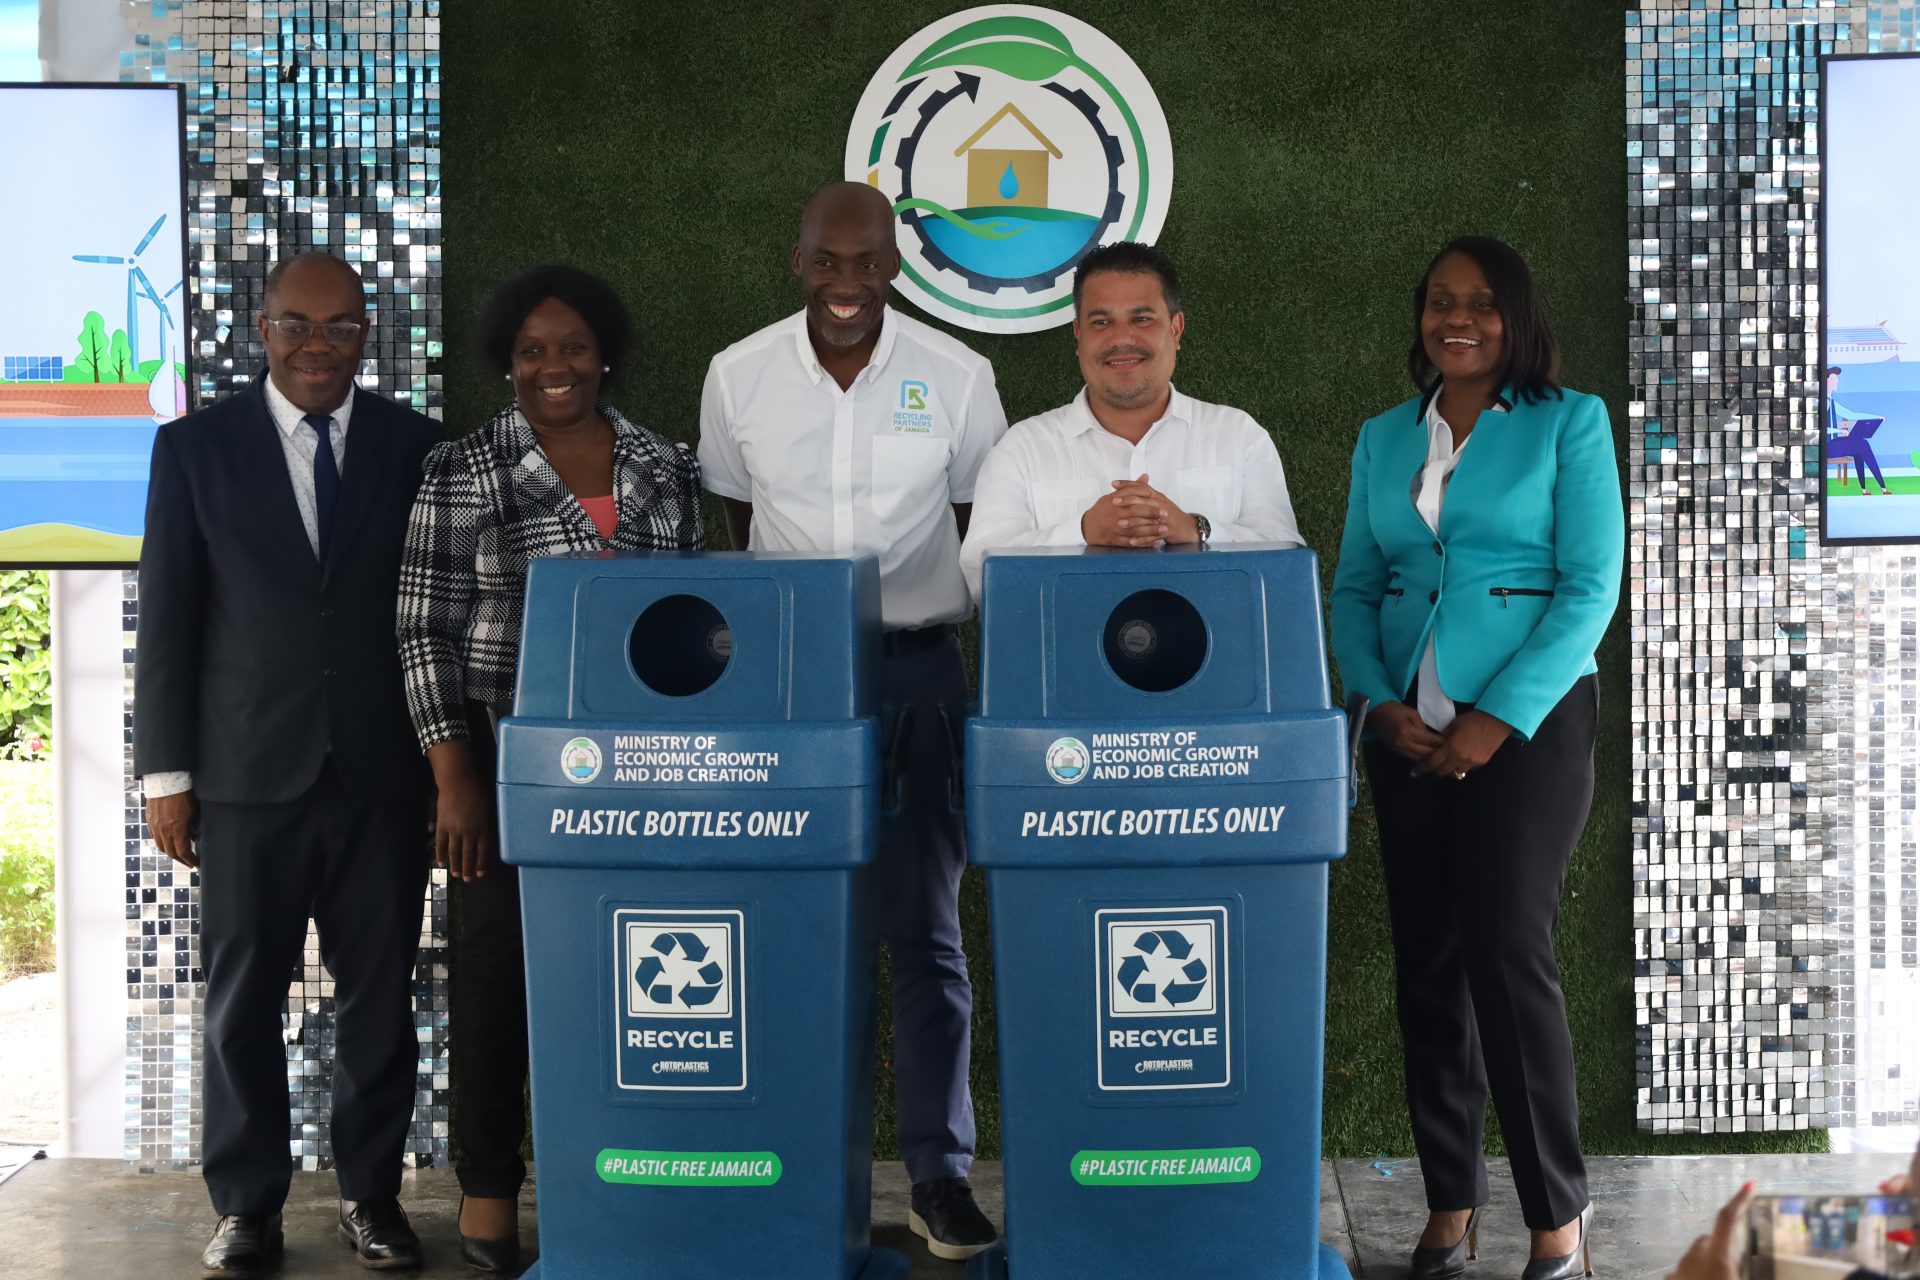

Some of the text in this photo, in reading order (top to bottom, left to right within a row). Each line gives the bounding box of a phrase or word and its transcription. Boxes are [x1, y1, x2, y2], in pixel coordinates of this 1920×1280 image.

[893, 412, 933, 421] RECYCLING
[893, 419, 933, 428] PARTNERS
[614, 735, 717, 750] MINISTRY OF
[1092, 731, 1198, 748] MINISTRY OF
[614, 752, 779, 767] ECONOMIC GROWTH
[1092, 745, 1259, 764] ECONOMIC GROWTH
[614, 768, 769, 783] AND JOB CREATION
[1092, 761, 1249, 780] AND JOB CREATION
[550, 808, 811, 837] PLASTIC BOTTLES ONLY
[1021, 806, 1286, 837] PLASTIC BOTTLES ONLY
[626, 1029, 734, 1049] RECYCLE
[1109, 1027, 1218, 1048] RECYCLE
[603, 1158, 773, 1177] #PLASTIC FREE JAMAICA
[1079, 1156, 1252, 1176] #PLASTIC FREE JAMAICA
